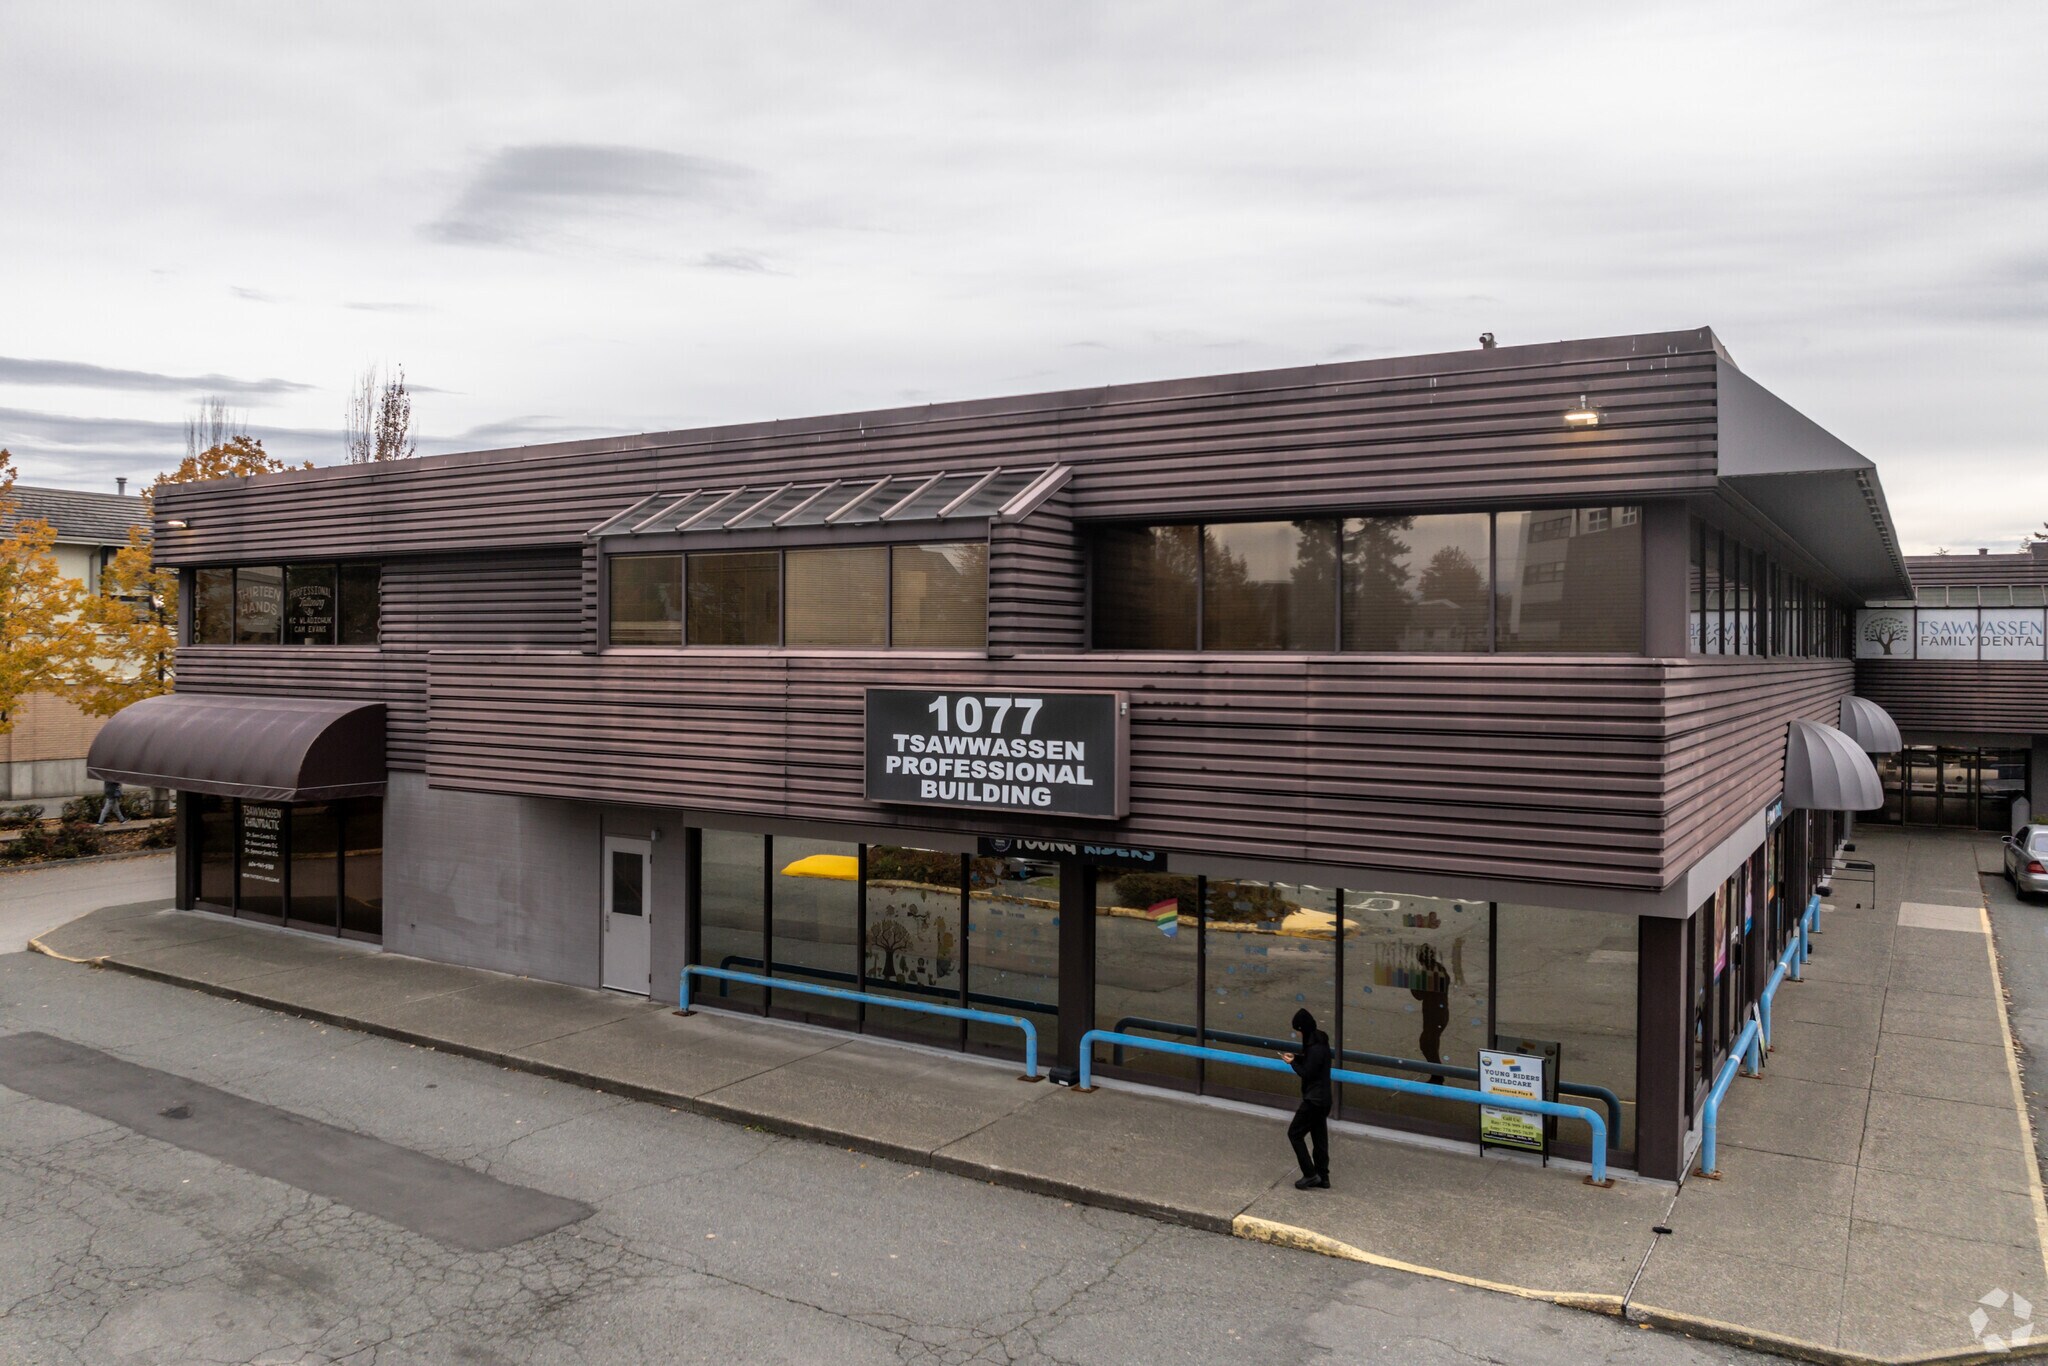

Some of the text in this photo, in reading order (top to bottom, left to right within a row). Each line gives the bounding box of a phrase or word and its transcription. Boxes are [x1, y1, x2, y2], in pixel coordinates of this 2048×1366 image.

[237, 585, 281, 602] THIRTEEN
[289, 585, 332, 599] PROFESSIONAL
[241, 601, 277, 615] HANDS
[308, 625, 327, 633] EVANS
[1918, 620, 2043, 635] TSAWWASSEN
[1921, 636, 2045, 646] FAMILY DENTAL
[928, 695, 1043, 735] 1077
[892, 733, 1085, 760] TSAWWASSEN
[885, 755, 1094, 785] PROFESSIONAL
[920, 779, 1051, 806] BUILDING
[243, 806, 281, 818] TSAWWASSEN
[244, 817, 280, 830] CHIROPRACTIC
[1485, 1069, 1540, 1081] YOUNG RIDERS
[1490, 1077, 1532, 1087] CHILDCARE
